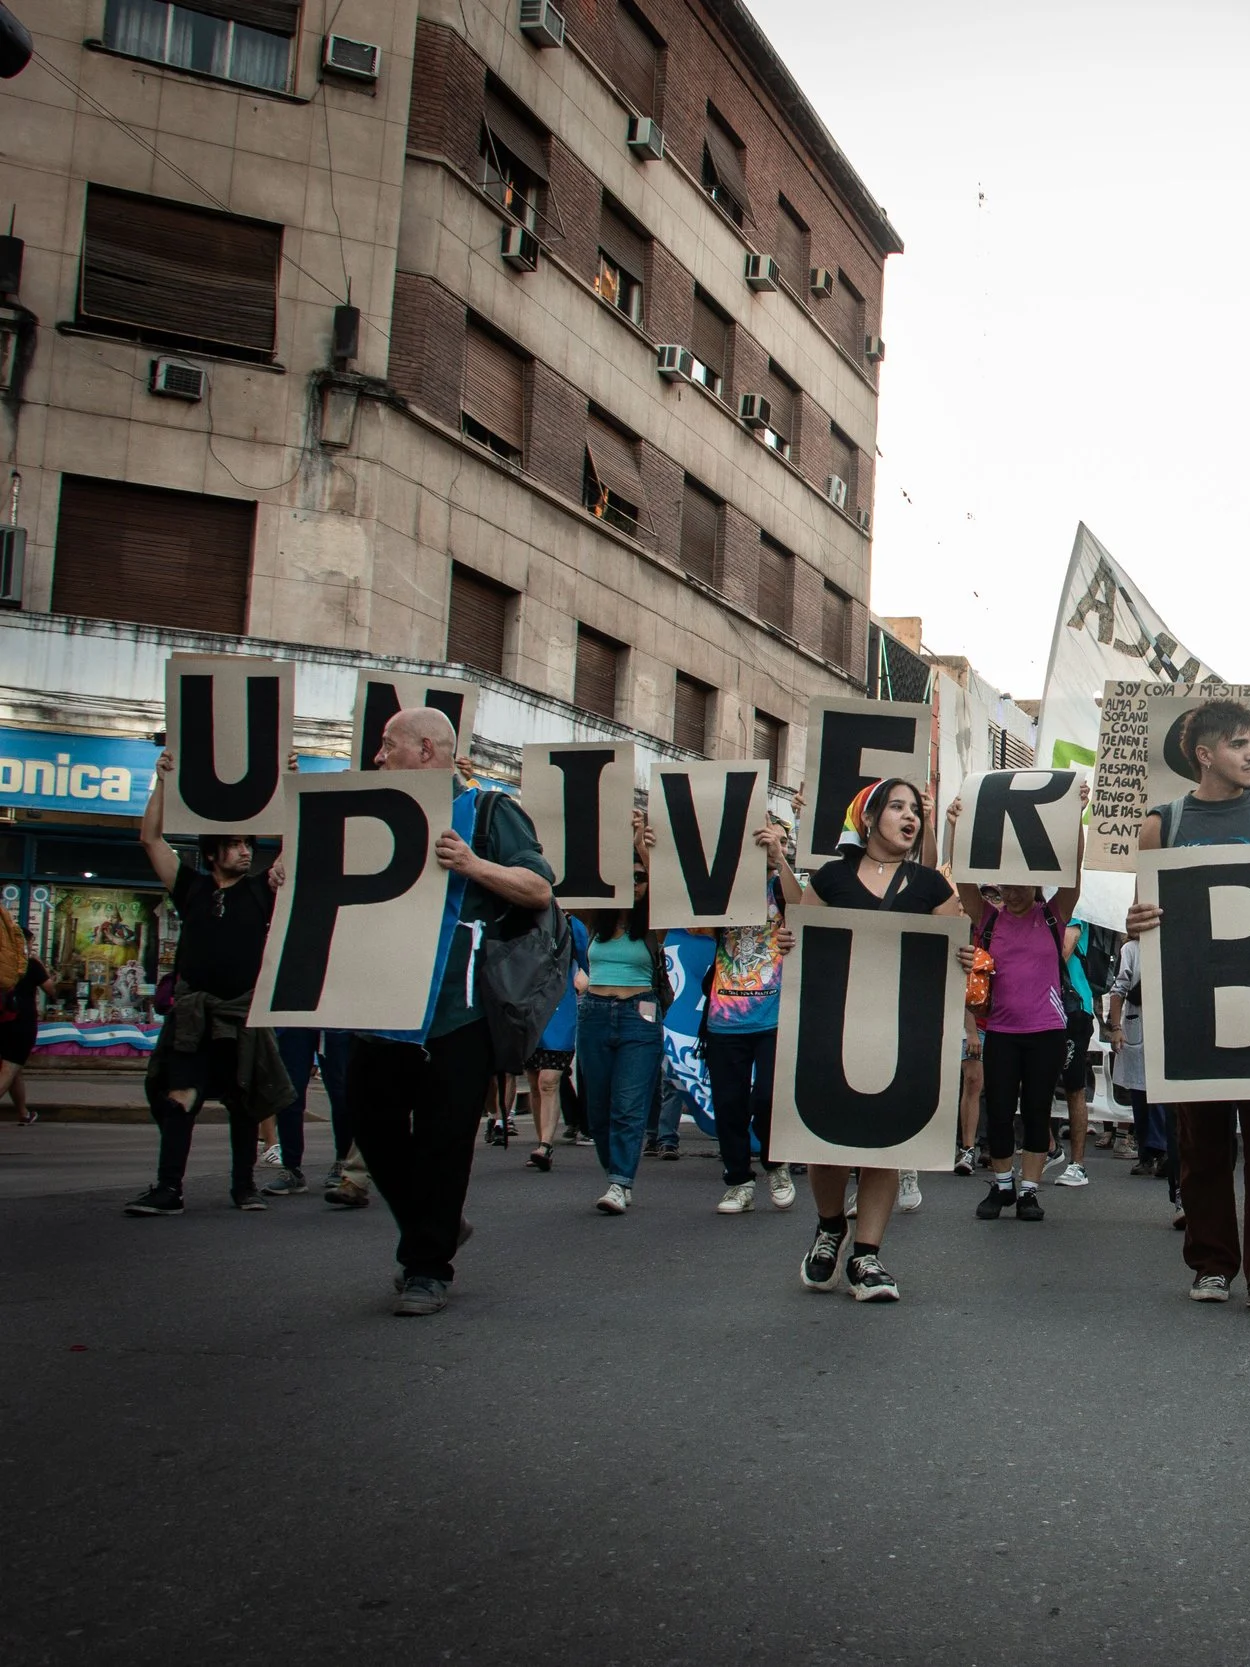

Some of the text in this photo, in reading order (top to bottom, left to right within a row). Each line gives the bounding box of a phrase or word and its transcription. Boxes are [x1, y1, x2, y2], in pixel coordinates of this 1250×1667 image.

[1105, 698, 1131, 712] ALMA
[1115, 682, 1142, 697] SOY
[1144, 684, 1176, 697] COYA
[1184, 683, 1193, 697] Y
[179, 675, 279, 822] U
[1100, 732, 1140, 747] TIENEN
[1100, 746, 1111, 759] Y
[1113, 748, 1128, 759] EL
[0, 753, 132, 802] onica
[1097, 776, 1112, 787] EL
[1091, 804, 1120, 818] VALE
[1095, 789, 1136, 802] TENGO
[549, 750, 616, 898] I
[969, 770, 1076, 871] R
[656, 771, 758, 916] V
[271, 789, 429, 1012] P
[794, 926, 948, 1147] U
